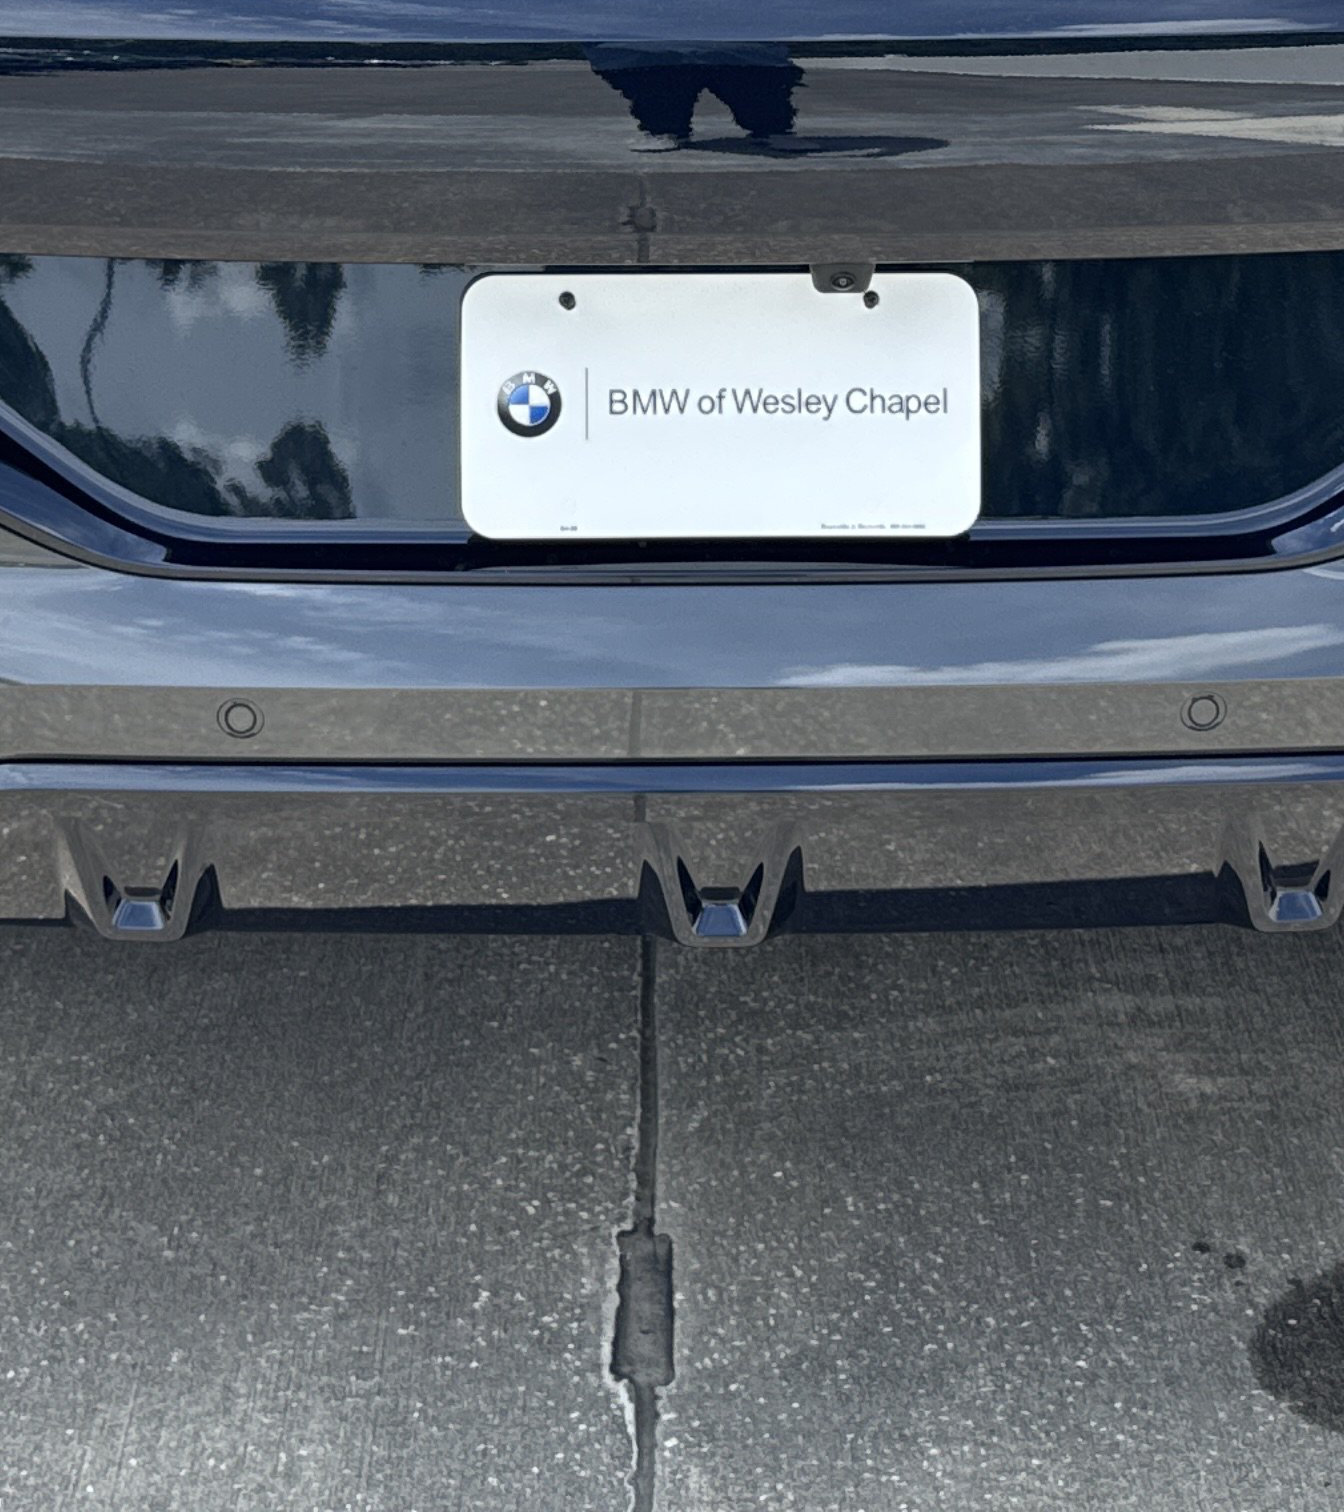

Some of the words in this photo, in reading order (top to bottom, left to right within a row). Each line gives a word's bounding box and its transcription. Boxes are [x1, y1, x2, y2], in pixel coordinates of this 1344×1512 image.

[608, 388, 690, 415] BMW
[697, 387, 727, 415] of
[731, 387, 838, 421] Wesley
[845, 387, 948, 421] Chapel
